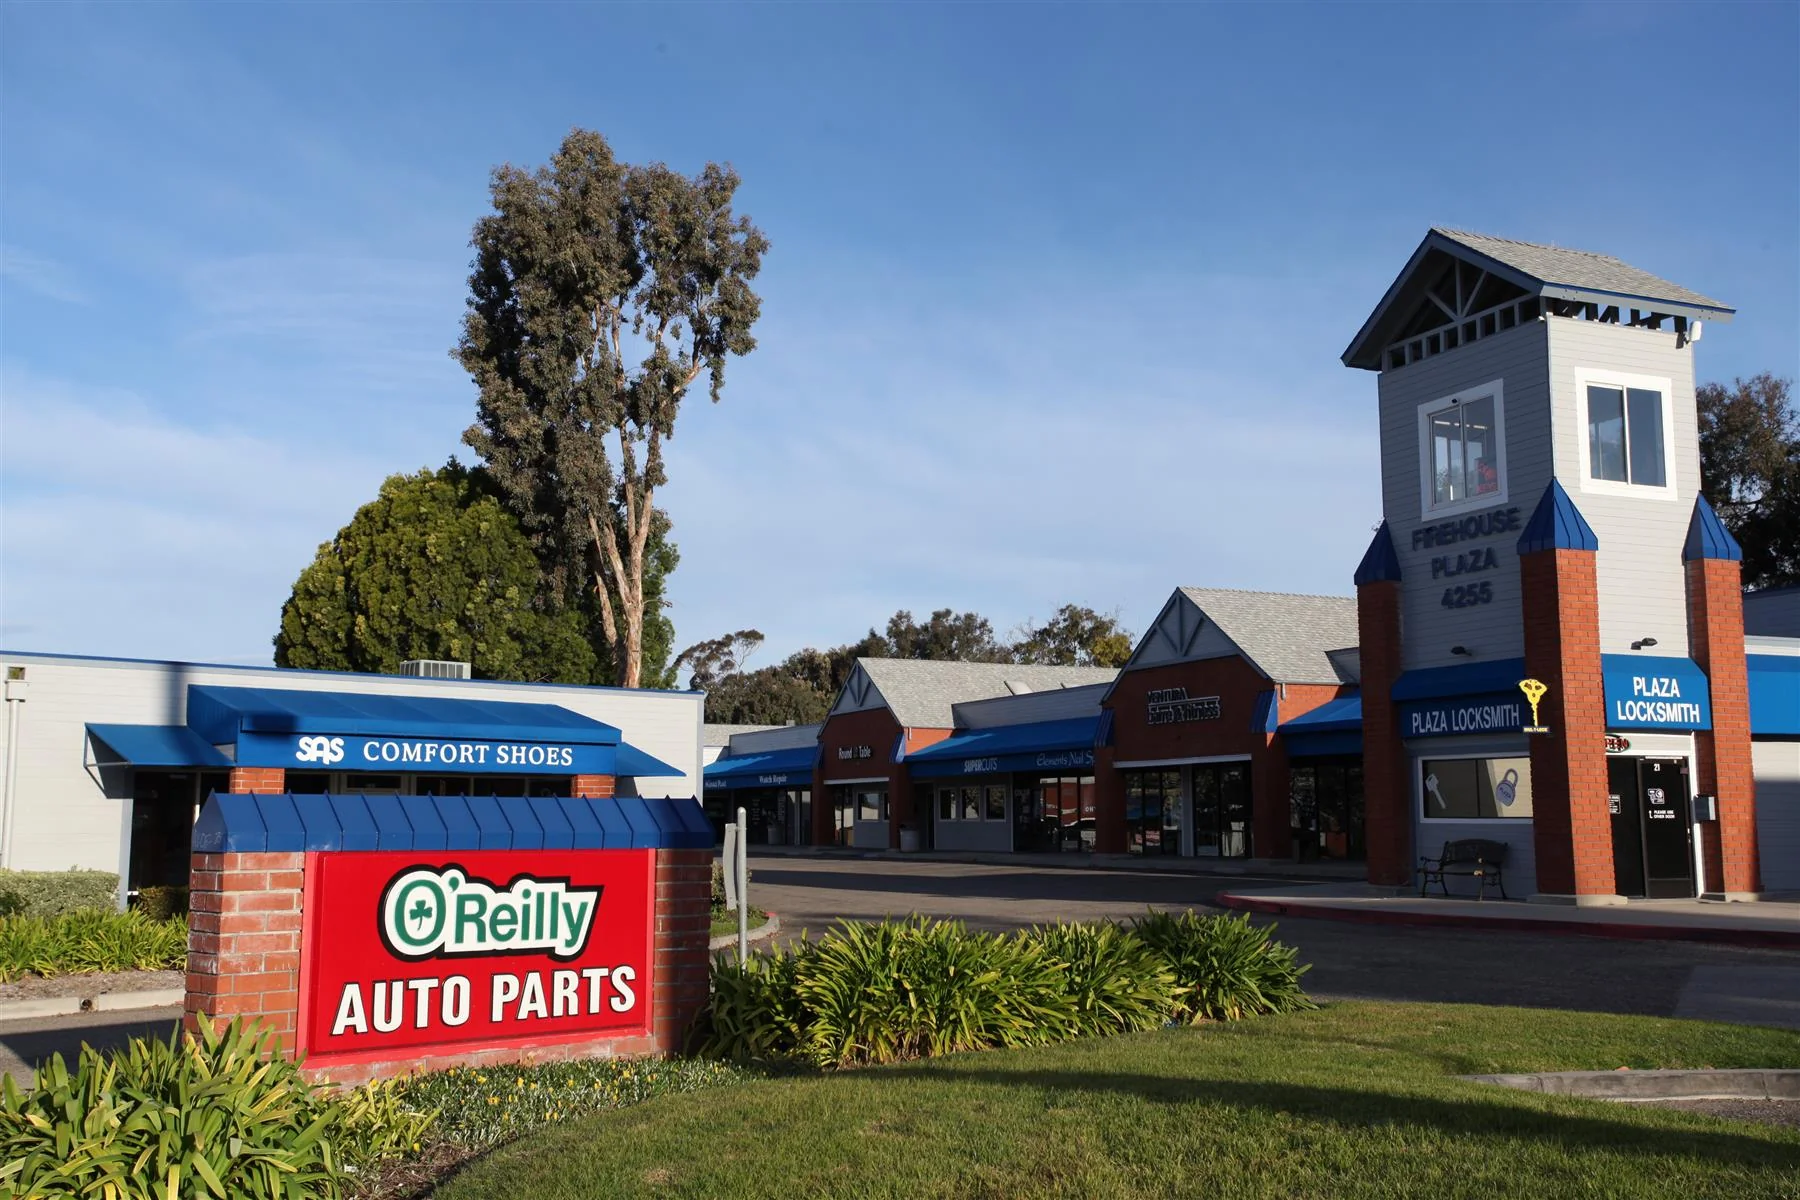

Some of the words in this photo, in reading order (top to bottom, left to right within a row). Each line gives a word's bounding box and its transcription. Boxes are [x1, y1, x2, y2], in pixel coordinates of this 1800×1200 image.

[1412, 507, 1522, 551] FIREHOUSE
[1431, 547, 1499, 579] PLAZA
[1441, 581, 1493, 609] 4255
[1632, 677, 1680, 697] PLAZA
[1412, 711, 1448, 733] PLAZA
[1452, 704, 1520, 732] LOCKSMITH
[1617, 700, 1700, 723] LOCKSMITH
[296, 736, 345, 765] SAS
[363, 741, 490, 764] COMFORT
[496, 745, 573, 766] SHOES
[1605, 738, 1630, 750] PEN
[964, 758, 998, 773] SUPERCUTS
[1036, 752, 1067, 767] Elements
[1069, 751, 1084, 767] Nail
[772, 774, 787, 785] Repair
[393, 876, 590, 949] O'Reilly
[331, 975, 471, 1036] AUTO
[490, 965, 637, 1023] PARTS
